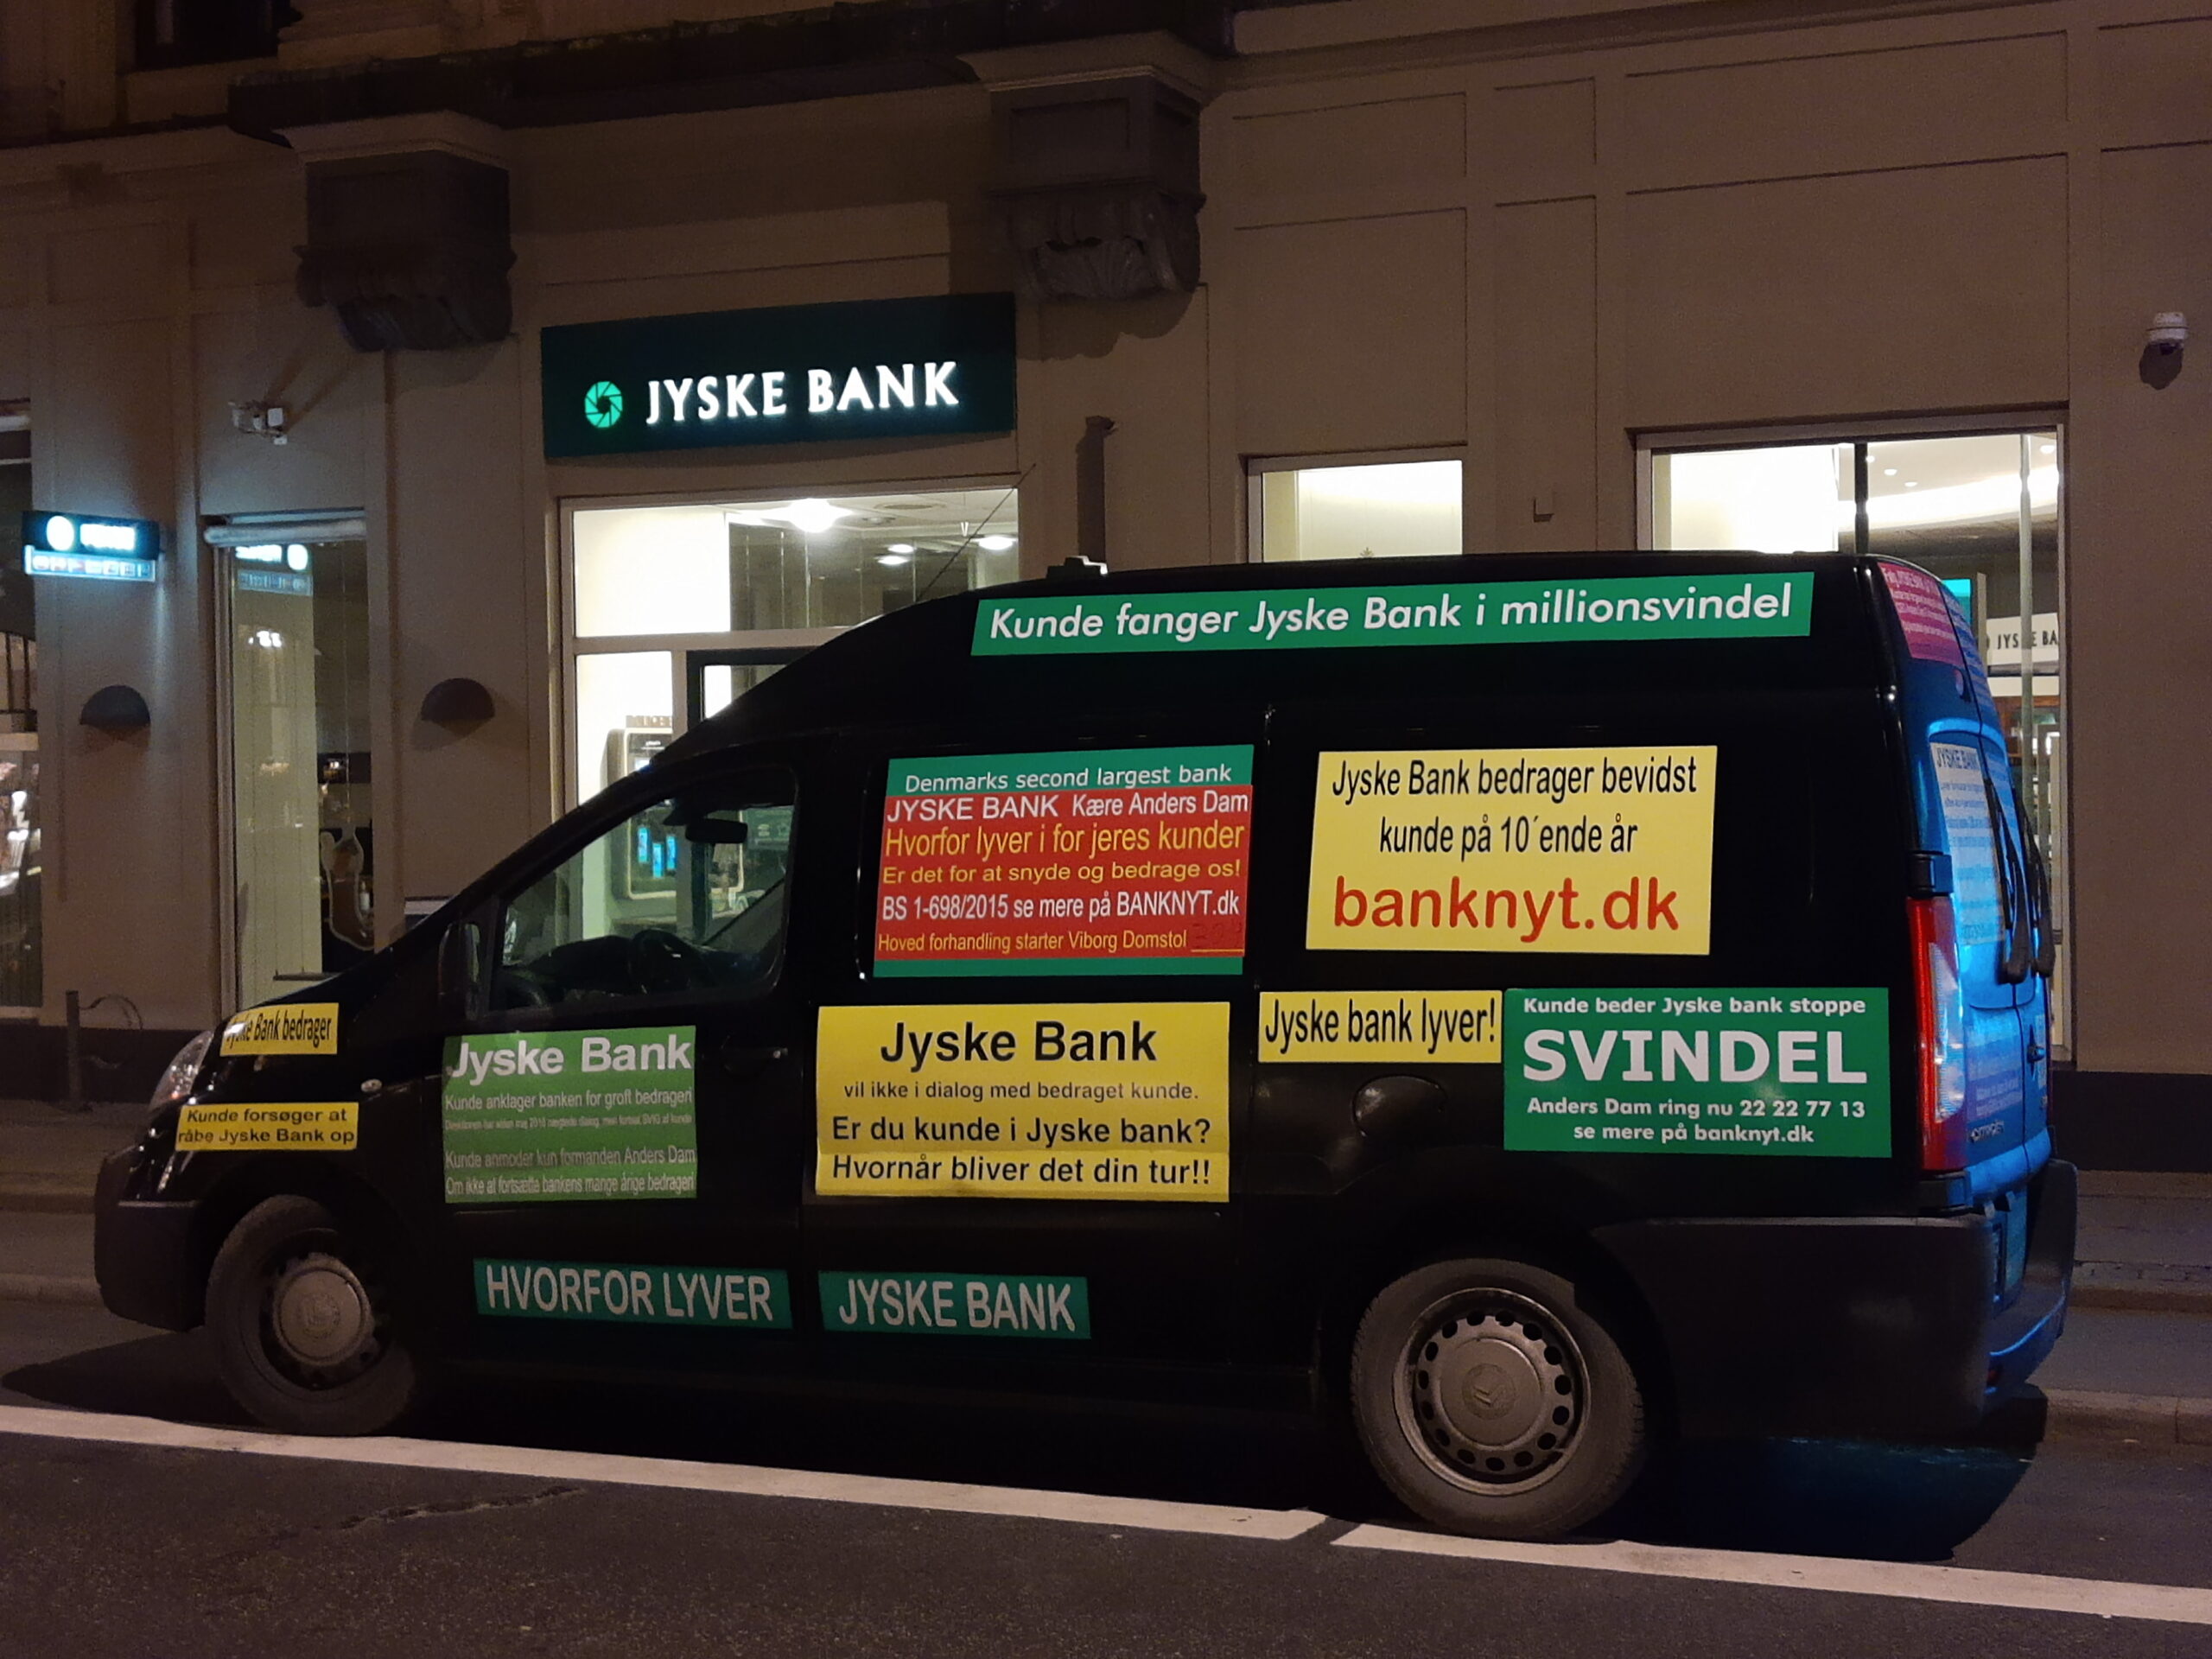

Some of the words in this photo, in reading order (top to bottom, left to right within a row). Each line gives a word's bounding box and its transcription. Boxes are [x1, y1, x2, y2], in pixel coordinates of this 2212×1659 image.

[645, 371, 786, 425] JYSKE
[808, 360, 959, 413] BANK
[990, 605, 1103, 639] Kunde
[1116, 602, 1237, 643] fanger
[1249, 598, 1349, 639] Jyske
[1364, 594, 1460, 629] Bank
[1476, 594, 1486, 626] i
[1501, 583, 1791, 626] millionsvindel
[1997, 632, 2037, 650] JYSE
[906, 774, 1008, 793] Denmarks
[1015, 768, 1089, 787] second
[1096, 766, 1171, 790] largest
[1179, 764, 1231, 783] bank
[1332, 759, 1400, 805] Jyske
[1408, 760, 1470, 796] Bank
[1478, 758, 1595, 804] bedrager
[1602, 756, 1697, 794] bevidst
[887, 797, 974, 823] JYSKE
[982, 794, 1059, 819] BANK
[1072, 793, 1122, 817] Kære
[1128, 791, 1197, 815] Anders
[1203, 790, 1248, 813] Dam
[885, 827, 969, 856] Hvorfor
[976, 825, 1033, 861] lyver
[1039, 824, 1046, 853] i
[1052, 823, 1085, 853] for
[1088, 822, 1150, 859] jeres
[1158, 820, 1244, 850] kunder
[1379, 817, 1454, 853] kunde
[1461, 814, 1491, 862] på
[1611, 813, 1638, 853] år
[882, 867, 906, 884] Er
[911, 865, 944, 884] det
[950, 865, 976, 882] for
[982, 865, 1001, 882] at
[1008, 862, 1071, 886] snyde
[1078, 865, 1104, 884] og
[1111, 860, 1200, 882] bedrage
[1208, 859, 1241, 877] os!
[882, 896, 907, 921] BS
[914, 893, 1008, 920] 1-698/2015
[1014, 898, 1033, 918] se
[1039, 897, 1084, 918] mere
[1089, 892, 1111, 923] på
[1116, 890, 1240, 918] BANKNYT.dk
[1333, 875, 1679, 943] banknyt.dk
[878, 933, 925, 952] Hoved
[929, 931, 1011, 955] forhandling
[1015, 930, 1065, 950] starter
[1068, 930, 1117, 953] Viborg
[1122, 928, 1187, 949] Domstol
[1523, 998, 1589, 1014] Kunde
[1595, 998, 1656, 1014] beder
[1662, 998, 1723, 1017] Jyske
[1729, 998, 1783, 1014] bank
[1789, 1000, 1866, 1018] stoppe
[253, 1010, 280, 1041] Bank
[283, 1009, 332, 1048] bedrager
[1264, 998, 1340, 1055] Jyske
[1348, 998, 1412, 1044] bank
[1421, 998, 1496, 1053] lyver!
[452, 1039, 563, 1086] Jyske
[582, 1034, 691, 1072] Bank
[880, 1021, 1017, 1073] Jyske
[1034, 1020, 1158, 1062] Bank
[1522, 1029, 1867, 1084] SVINDEL
[445, 1094, 482, 1110] Kunde
[486, 1093, 536, 1112] anklager
[539, 1090, 582, 1108] banken
[586, 1090, 601, 1107] for
[606, 1089, 632, 1110] groft
[635, 1087, 692, 1107] bedrageri
[844, 1082, 864, 1098] vil
[870, 1082, 908, 1098] ikke
[914, 1082, 919, 1098] i
[925, 1082, 983, 1103] dialog
[990, 1082, 1031, 1099] med
[1038, 1082, 1124, 1103] bedraget
[1130, 1082, 1198, 1101] kunde.
[1528, 1097, 1599, 1116] Anders
[1605, 1098, 1653, 1116] Dam
[1659, 1099, 1700, 1120] ring
[1707, 1104, 1733, 1117] nu
[1739, 1101, 1766, 1117] 22
[1772, 1101, 1800, 1117] 22
[1805, 1101, 1832, 1118] 77
[1840, 1101, 1866, 1118] 13
[188, 1109, 238, 1122] Kunde
[244, 1109, 323, 1124] forsøger
[329, 1109, 347, 1122] at
[832, 1116, 861, 1141] Er
[870, 1116, 905, 1141] du
[914, 1116, 1001, 1142] kunde
[1009, 1116, 1016, 1142] i
[1027, 1117, 1110, 1147] Jyske
[1121, 1118, 1211, 1144] bank?
[178, 1128, 213, 1141] råbe
[219, 1130, 270, 1145] Jyske
[276, 1128, 324, 1141] Bank
[330, 1130, 354, 1144] op
[1573, 1127, 1595, 1140] se
[1602, 1127, 1655, 1141] mere
[1661, 1123, 1688, 1144] på
[1694, 1124, 1814, 1144] banknyt.dk
[445, 1151, 482, 1168] Kunde
[485, 1150, 534, 1167] anmoder
[537, 1150, 557, 1166] kun
[561, 1147, 621, 1166] formanden
[624, 1147, 664, 1164] Anders
[668, 1145, 696, 1163] Dam
[832, 1153, 943, 1180] Hvornår
[951, 1156, 1030, 1182] bliver
[1039, 1158, 1084, 1183] det
[1093, 1158, 1139, 1184] din
[1148, 1160, 1211, 1185] tur!!
[445, 1177, 464, 1196] Om
[466, 1176, 484, 1194] ikke
[542, 1174, 582, 1193] bankens
[585, 1176, 618, 1196] mange
[648, 1172, 695, 1195] bedrageri
[486, 1265, 654, 1318] HVORFOR
[663, 1272, 773, 1322] LYVER
[839, 1278, 957, 1328] JYSKE
[967, 1282, 1075, 1332] BANK
